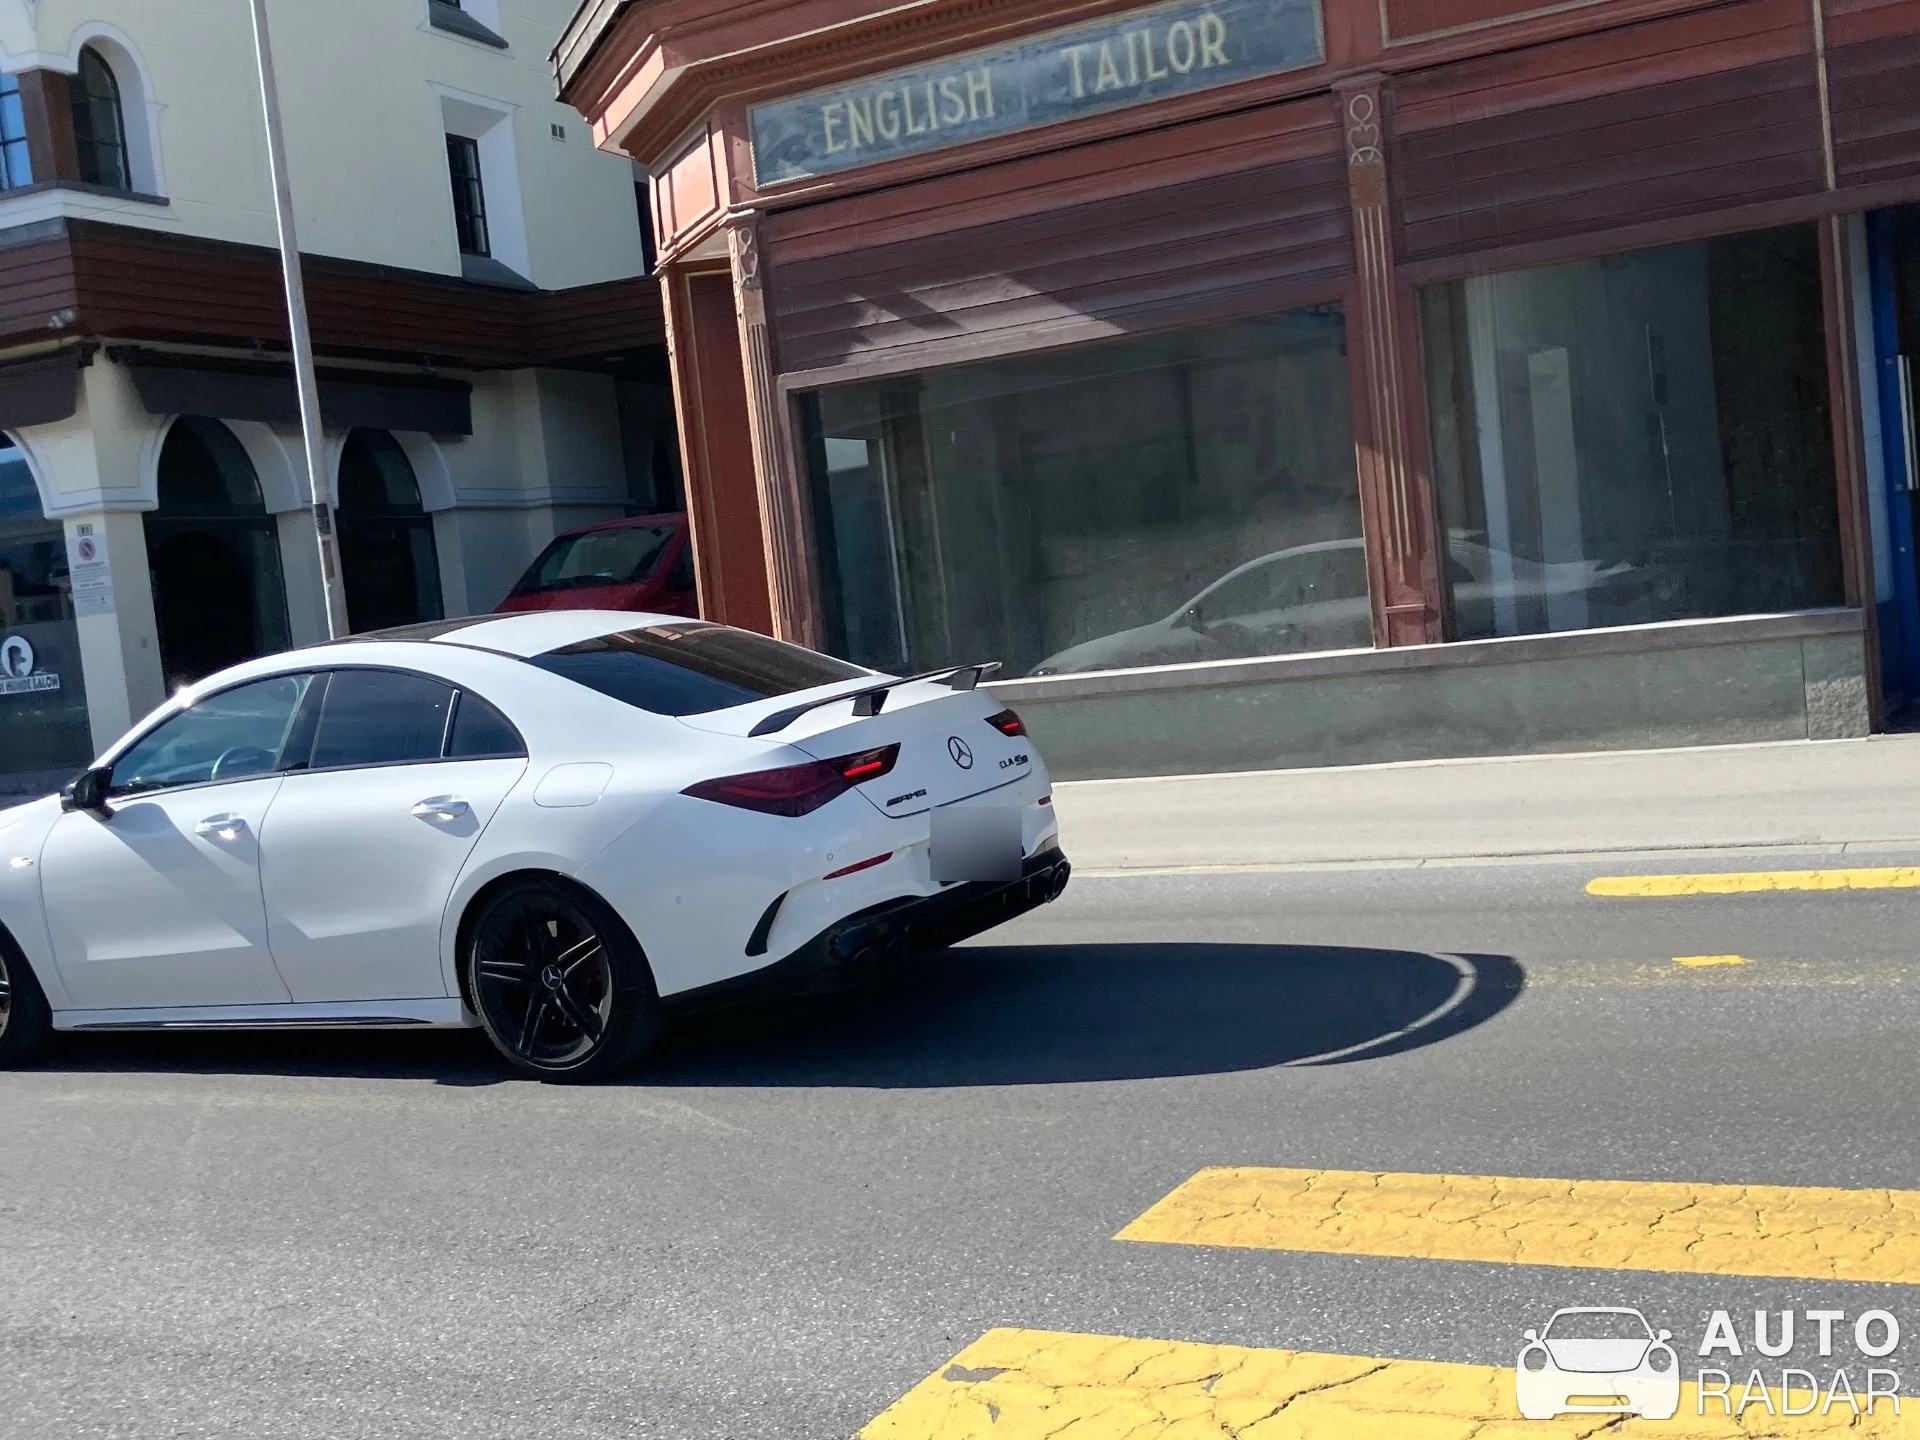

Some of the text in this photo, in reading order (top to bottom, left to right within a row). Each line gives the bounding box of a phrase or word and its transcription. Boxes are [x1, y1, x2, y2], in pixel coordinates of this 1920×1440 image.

[821, 12, 1232, 155] ENGLISH TAILOR
[999, 757, 1014, 769] CLA
